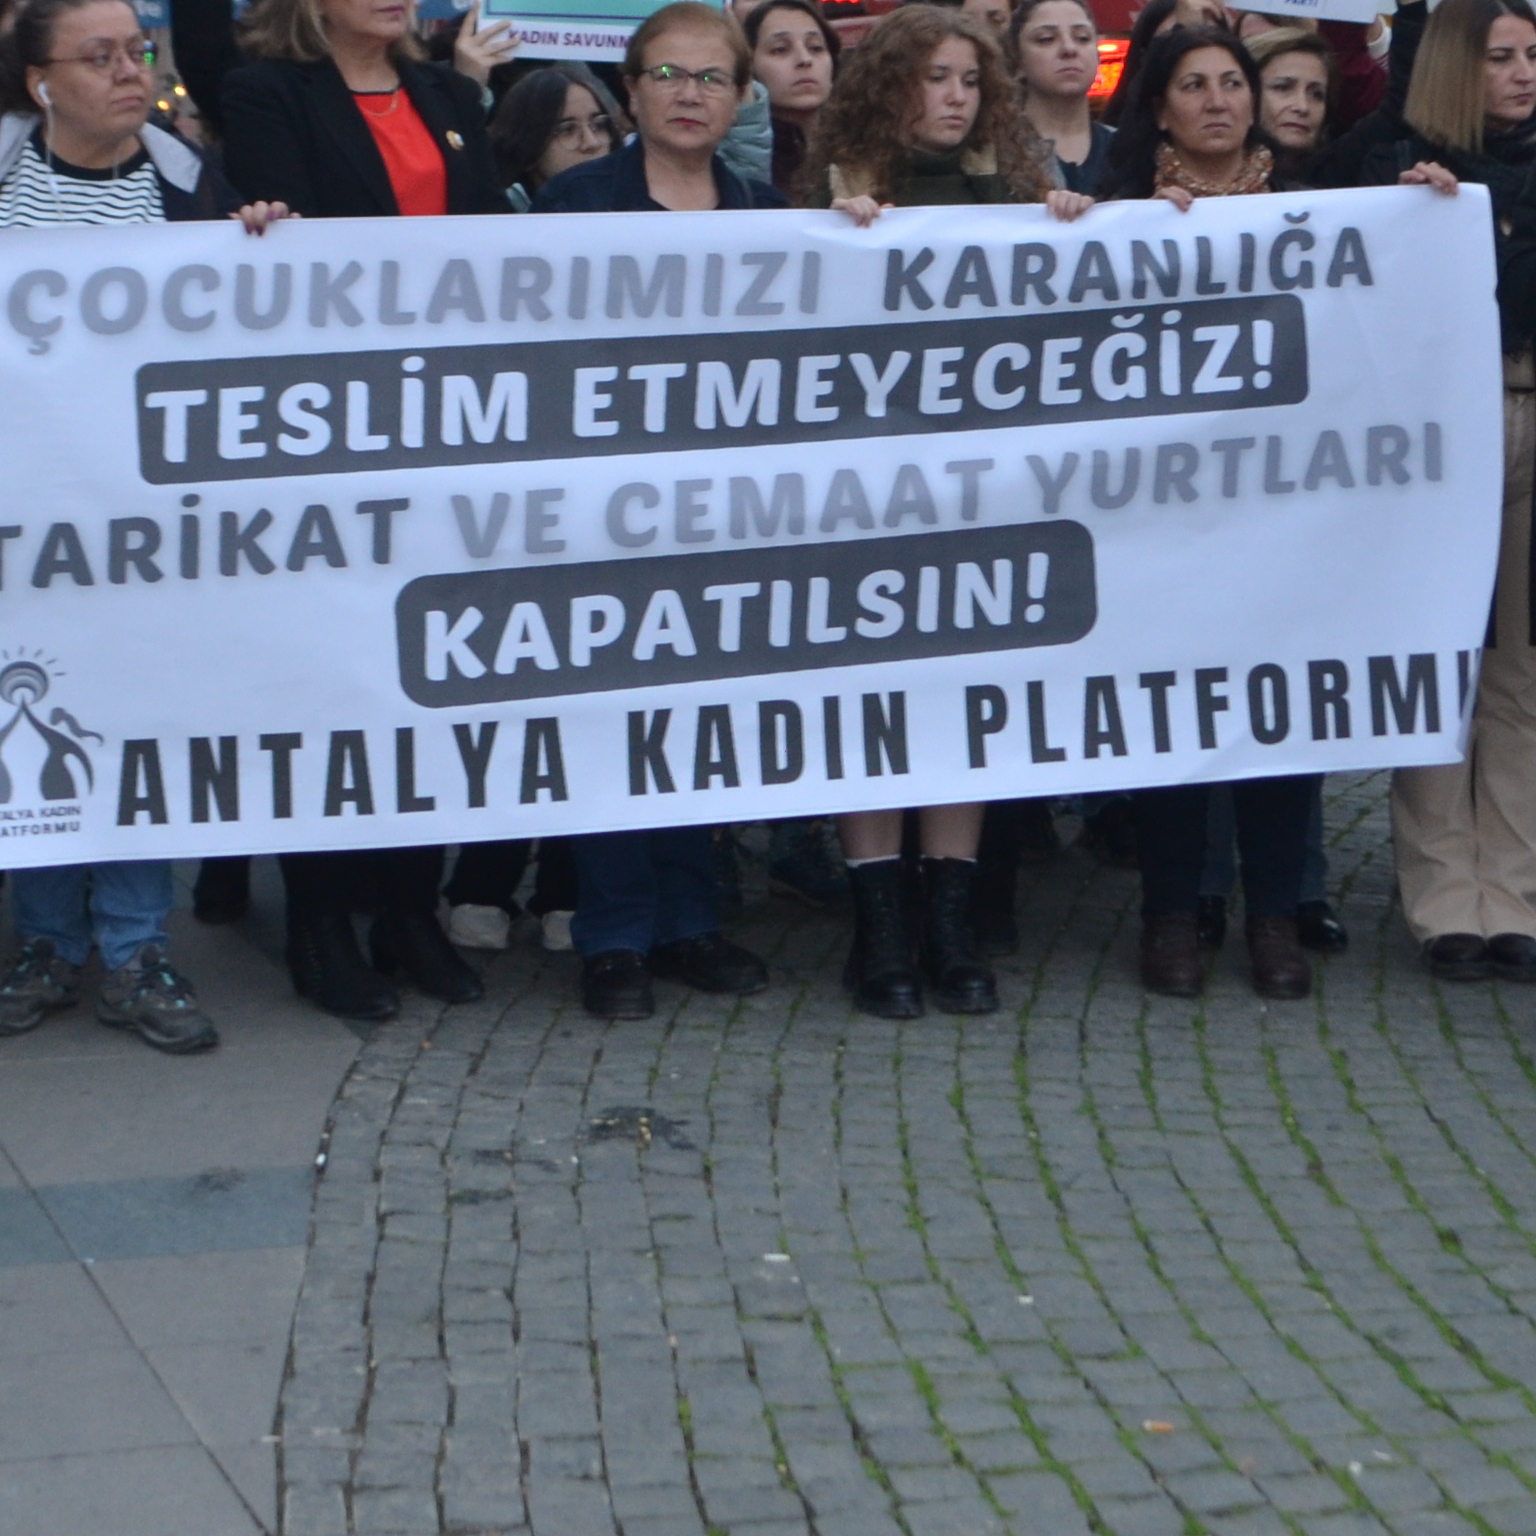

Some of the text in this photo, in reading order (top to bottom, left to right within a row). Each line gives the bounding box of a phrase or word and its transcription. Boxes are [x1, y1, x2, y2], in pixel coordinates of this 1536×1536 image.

[6, 211, 1375, 356] ÇOCUKLARIMIZI KARANLIĞA
[144, 309, 1276, 465] TESLİM ETMEYECEĞİZ!
[450, 487, 568, 560] VE
[604, 457, 996, 550] CEMAAT
[1024, 421, 1446, 516] YURTLARI
[422, 551, 1052, 683] KAPATILSIN!
[115, 716, 570, 828] ANTALYA
[627, 690, 912, 798] KADIN
